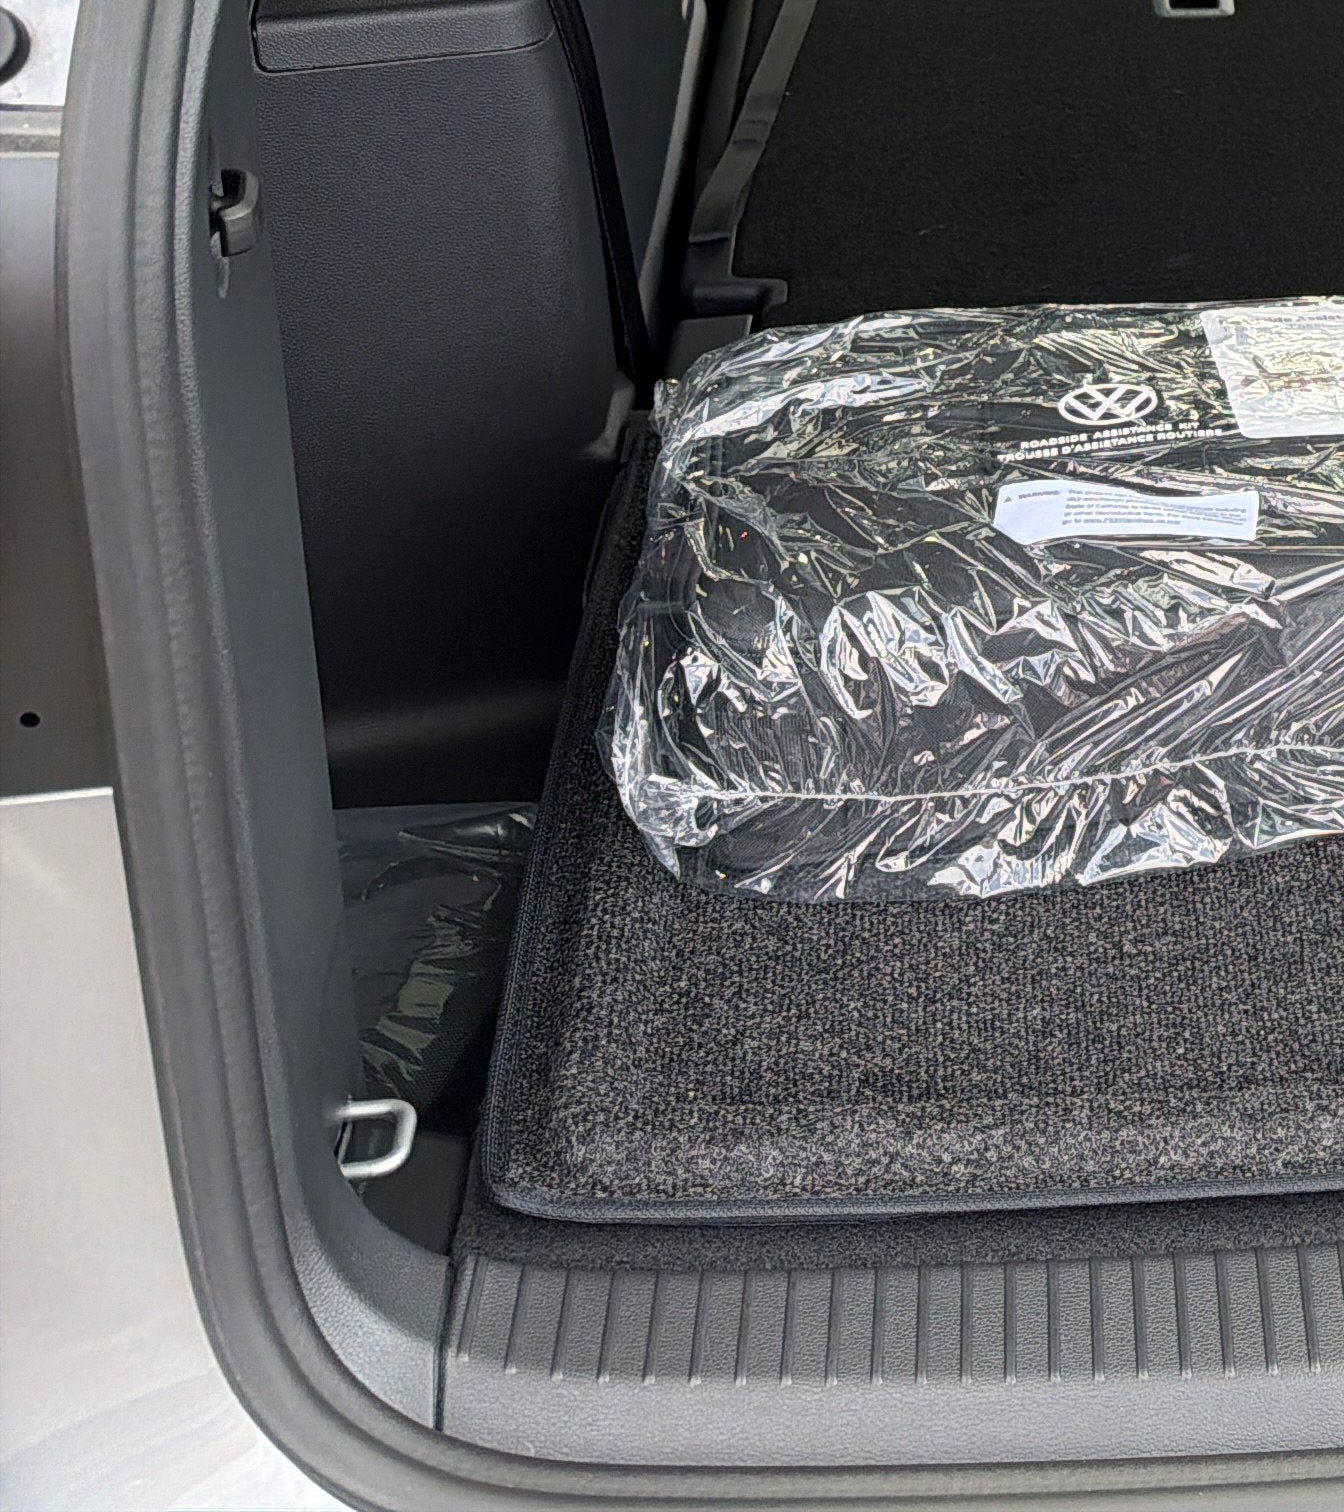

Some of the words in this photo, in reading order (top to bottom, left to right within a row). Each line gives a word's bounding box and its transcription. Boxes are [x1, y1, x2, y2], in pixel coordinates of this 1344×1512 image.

[996, 448, 1059, 461] TROUSSE
[1061, 433, 1154, 455] D'ASSISTANCE
[1021, 432, 1088, 450] ROADSIDE
[1092, 423, 1173, 440] ASSISTANCE
[1178, 421, 1200, 430] KIT
